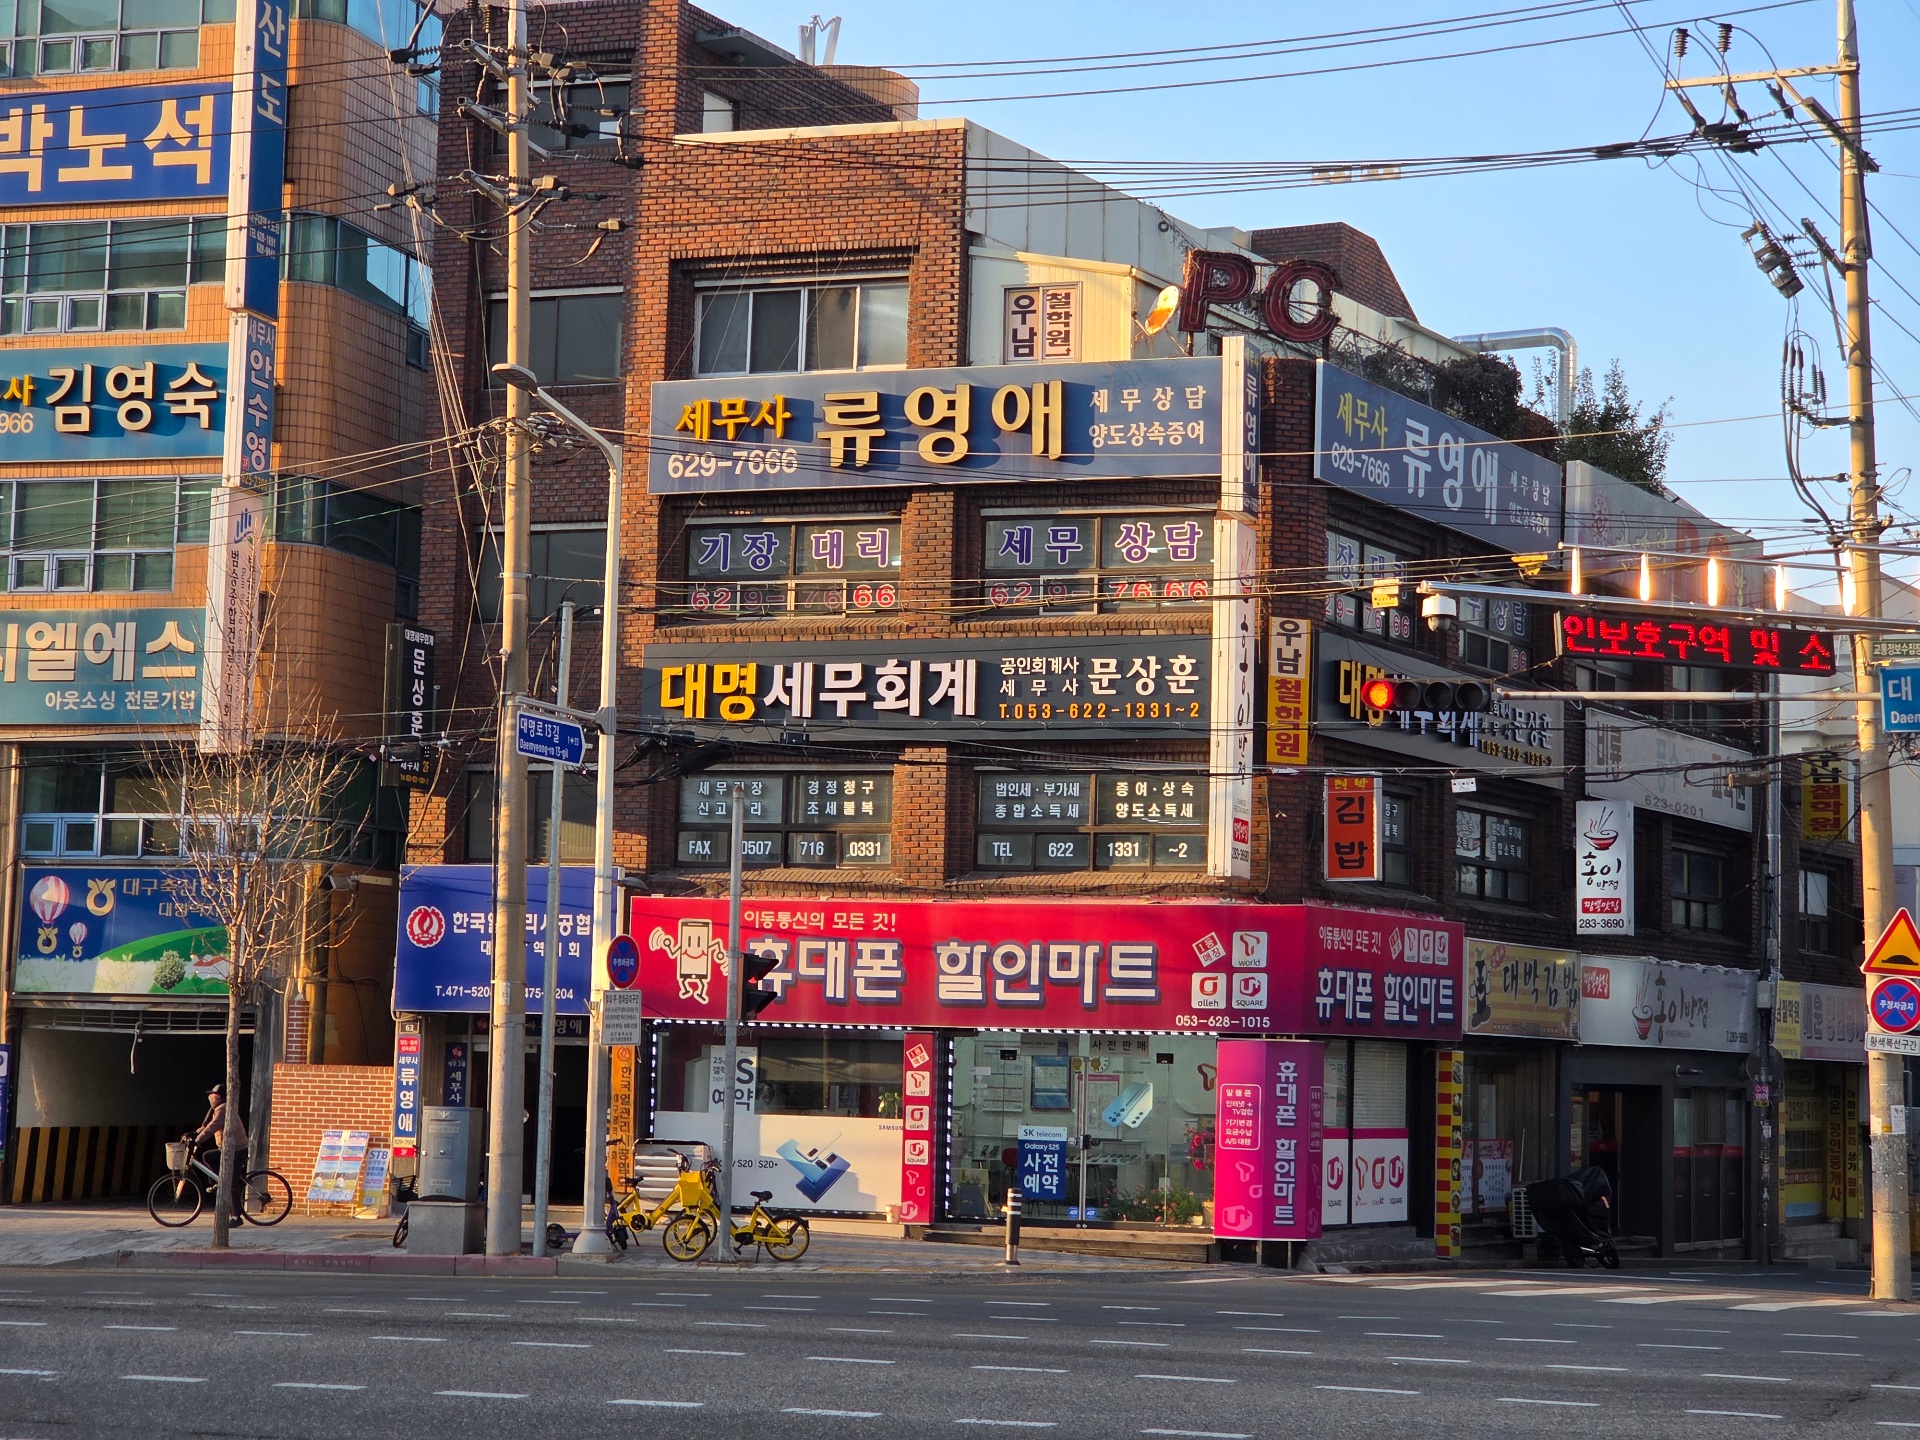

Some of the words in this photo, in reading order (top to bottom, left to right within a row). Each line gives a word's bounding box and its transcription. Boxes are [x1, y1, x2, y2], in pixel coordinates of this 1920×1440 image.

[1179, 250, 1343, 343] PC
[1011, 294, 1038, 358] 우남
[1045, 291, 1073, 348] 철학원
[248, 318, 275, 351] 세무사
[46, 361, 219, 434] 김영숙
[245, 349, 273, 472] 안수영
[1089, 385, 1207, 413] 세무상담
[674, 394, 793, 443] 세무사
[816, 379, 1063, 468] 류영애
[1088, 420, 1205, 448] 양도상속증여
[1336, 391, 1389, 450] 세무사
[667, 447, 798, 479] 629-7666
[1331, 441, 1390, 488] 629-7666
[1402, 417, 1499, 525] 류영애
[698, 531, 780, 572] 기장
[810, 528, 890, 569] 대리
[998, 525, 1083, 565] 세무
[1115, 521, 1203, 562] 상담
[1276, 619, 1302, 675] 우남
[1563, 614, 1731, 664] 인보호구역
[1750, 629, 1781, 667] 및
[1799, 633, 1831, 670] 소
[1000, 656, 1080, 675] 공인회계사
[1087, 654, 1200, 696] 문상훈
[44, 690, 116, 713] 아웃소싱
[124, 690, 197, 712] 전문기업
[411, 648, 426, 743] 문상훈
[660, 658, 977, 721] 대명세무회계
[1000, 678, 1079, 697] 세무사
[1888, 675, 1913, 702] 대
[1274, 679, 1303, 758] 철학원
[807, 779, 874, 796] 경정청구
[697, 801, 763, 816] 신고리
[807, 801, 874, 816] 조세불복
[994, 803, 1080, 818] 종합소득세
[1115, 803, 1193, 818] 양도소득세
[1644, 794, 1705, 818] 623-0201
[1808, 785, 1843, 833] 철학원
[1334, 795, 1369, 869] 김밥
[688, 840, 711, 855] FAX
[742, 840, 772, 855] 0507
[800, 841, 824, 856] 716
[849, 841, 882, 857] 0331
[992, 841, 1013, 857] TEL
[1048, 842, 1074, 857] 622
[1107, 842, 1140, 857] 1331
[743, 910, 825, 931] 이동통신의
[832, 912, 865, 931] 모든
[872, 912, 896, 932] 것!
[1578, 918, 1625, 929] 283-3690
[1318, 925, 1354, 952] 이동통신의
[1355, 930, 1369, 953] 모든
[612, 957, 635, 967] 주정차금지
[936, 941, 1156, 1003] 할인마트
[1238, 958, 1261, 967] world
[1235, 999, 1264, 1007] SQUARE
[1315, 968, 1374, 1020] 휴대폰
[1383, 973, 1454, 1025] 할인마트
[1879, 999, 1915, 1011] 주정차금지
[405, 1024, 415, 1032] 63
[1175, 1014, 1271, 1028] 053-628-1015
[1869, 1036, 1918, 1051] 황색복선구간
[398, 1056, 418, 1065] 세무사
[398, 1067, 415, 1132] 류영애
[1225, 1100, 1245, 1109] 인터넷
[1275, 1060, 1299, 1127] 휴대폰
[1023, 1129, 1035, 1137] SK
[1225, 1118, 1253, 1127] 기기변경
[369, 1150, 389, 1160] STB
[1024, 1142, 1048, 1151] Galaxy
[737, 1159, 753, 1168] S20
[758, 1160, 779, 1168] S20+
[1023, 1153, 1059, 1173] 사전
[1828, 1122, 1842, 1202] 공인중개사
[1023, 1173, 1059, 1194] 예약
[1272, 1137, 1297, 1226] 할인마트
[1327, 1199, 1342, 1208] SQUARE
